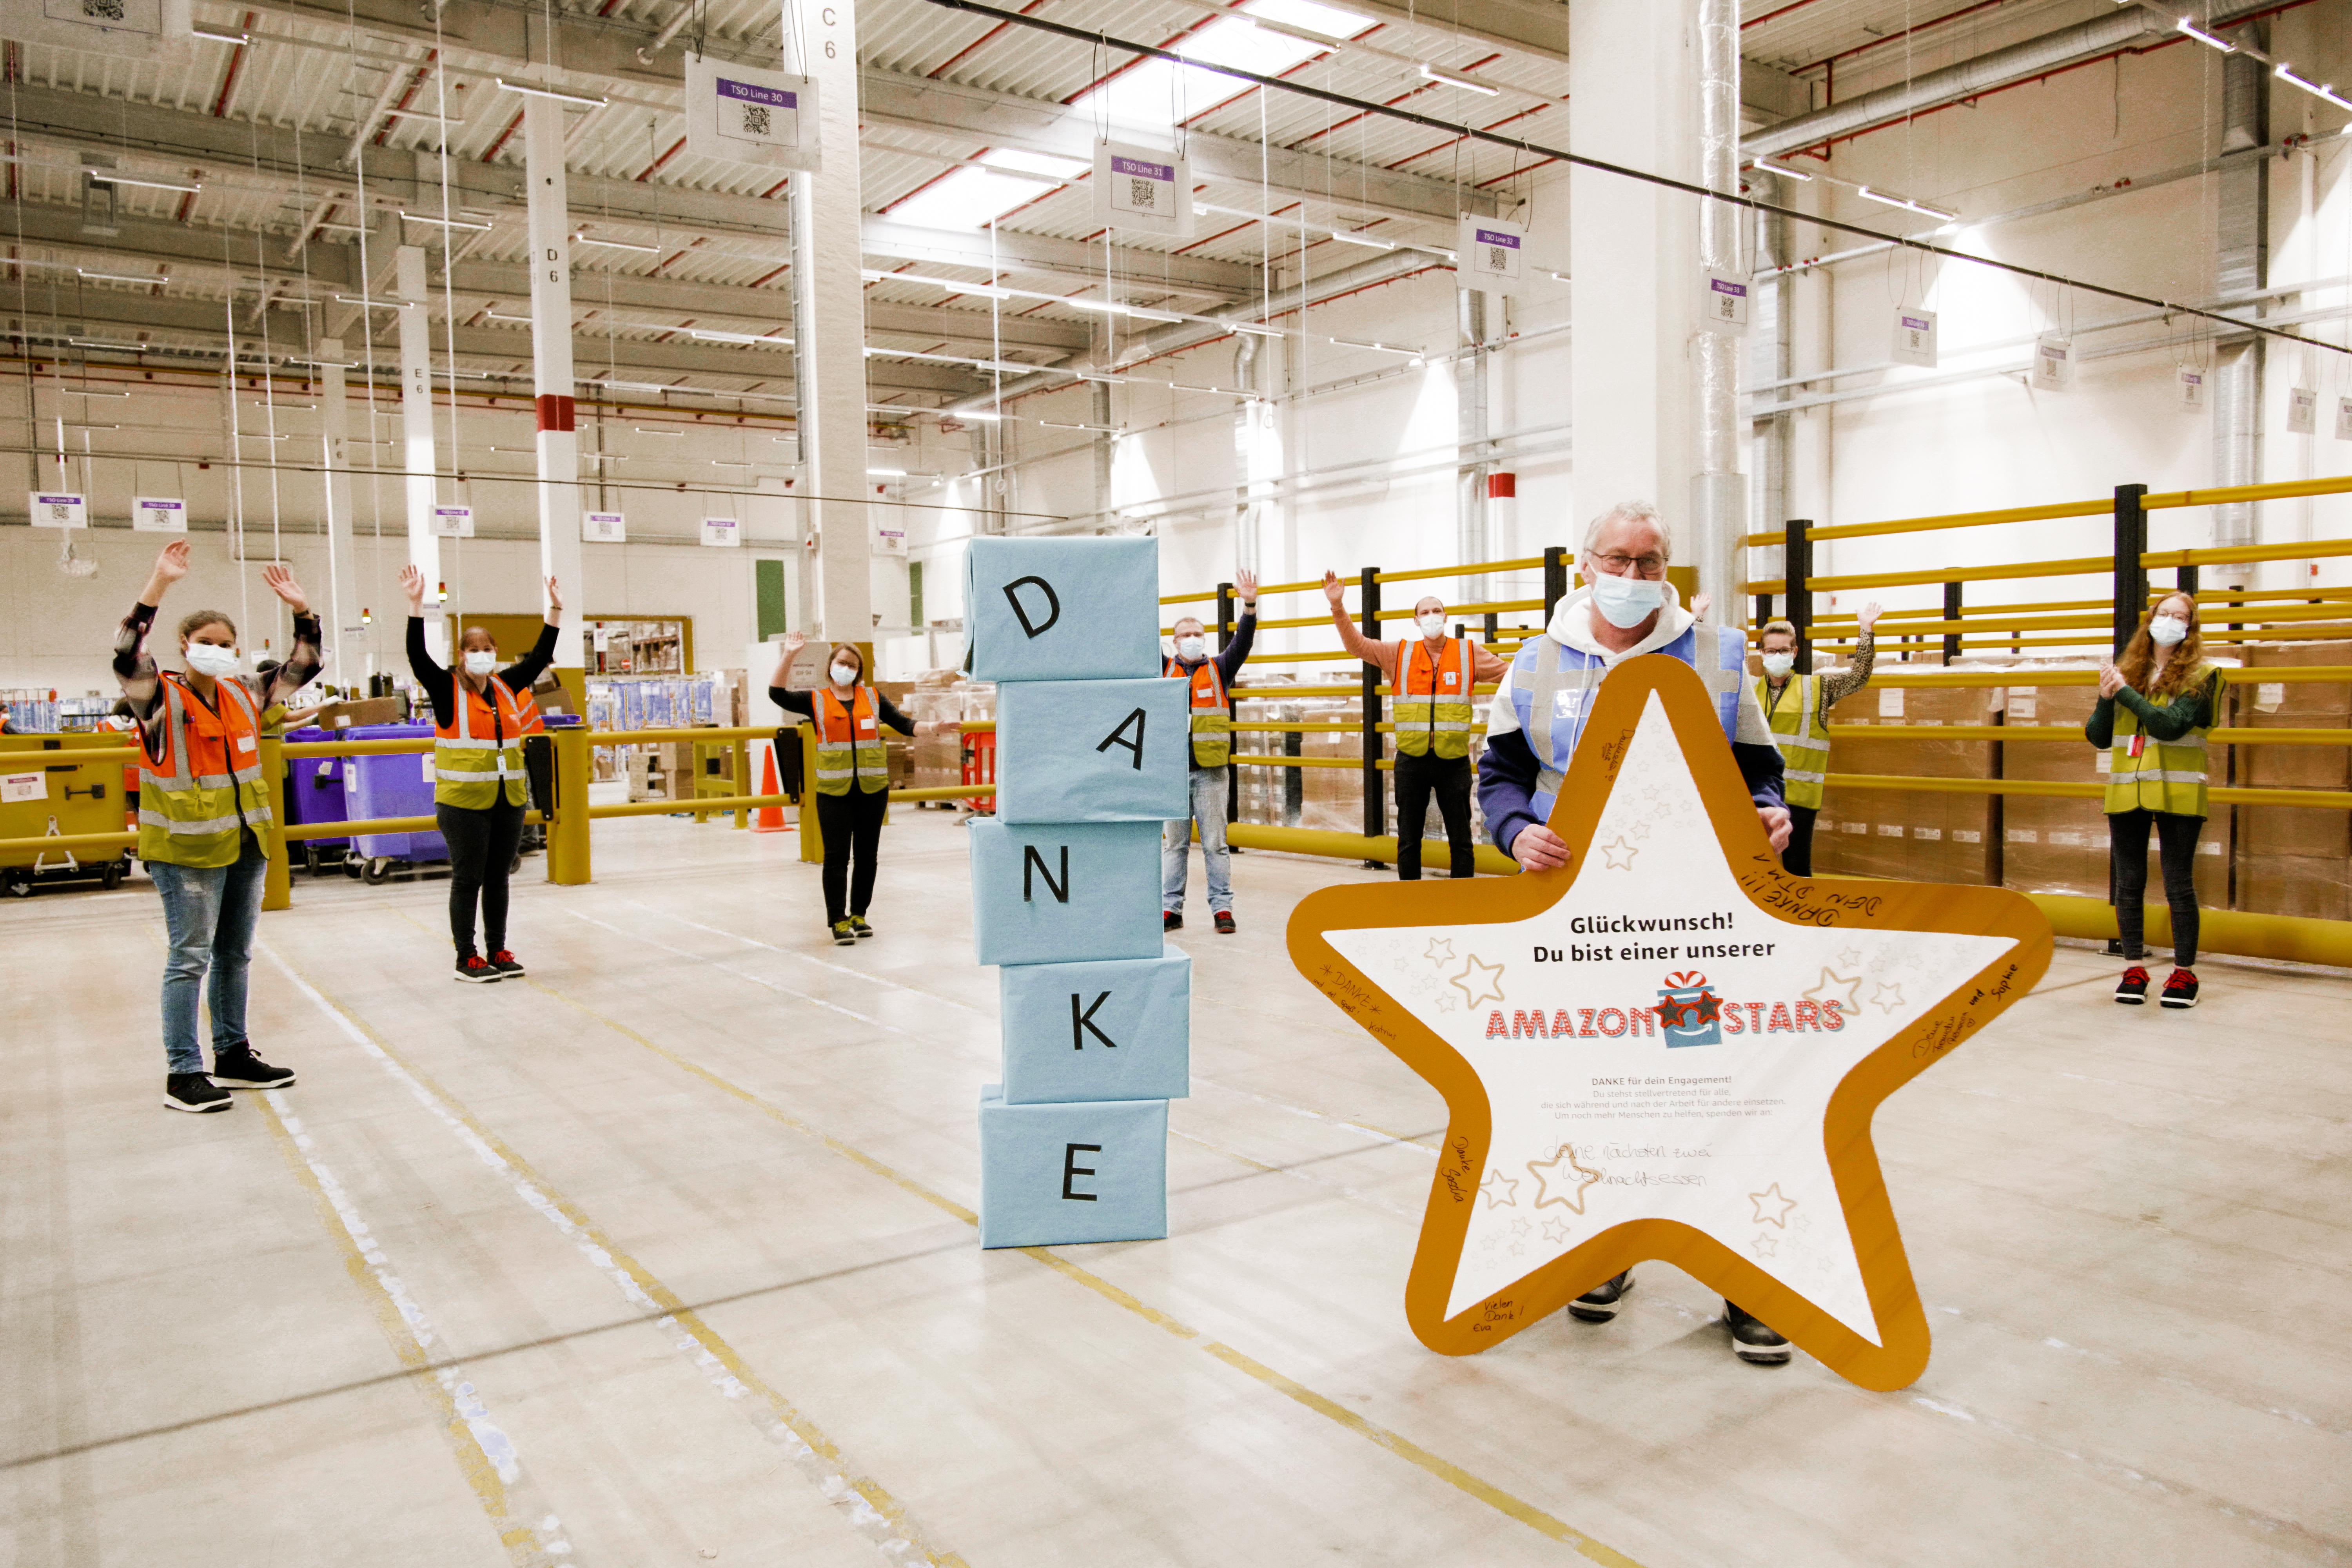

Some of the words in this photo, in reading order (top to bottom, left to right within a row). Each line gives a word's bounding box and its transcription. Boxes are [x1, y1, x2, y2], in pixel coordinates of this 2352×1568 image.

[822, 8, 835, 26] C
[825, 41, 835, 59] 6
[731, 84, 748, 96] TSO
[751, 87, 768, 100] Line
[771, 93, 782, 102] 30
[1122, 162, 1136, 171] TSO
[1138, 165, 1152, 174] Line
[1154, 168, 1163, 177] 31
[547, 249, 558, 261] D
[550, 270, 558, 282] 6
[1571, 913, 1733, 934] Glückwunsch!
[1534, 946, 1563, 962] Du
[1572, 943, 1613, 962] bist
[1621, 942, 1679, 960] einer
[1687, 944, 1775, 959] unserer
[1485, 1007, 1655, 1039] AMAZON
[1724, 1000, 1845, 1034] STARS
[1669, 1076, 1731, 1085] Engagement!
[1635, 1089, 1697, 1097] stellvertretend
[1706, 1109, 1742, 1118] spenden
[1485, 1298, 1513, 1310] Vielen
